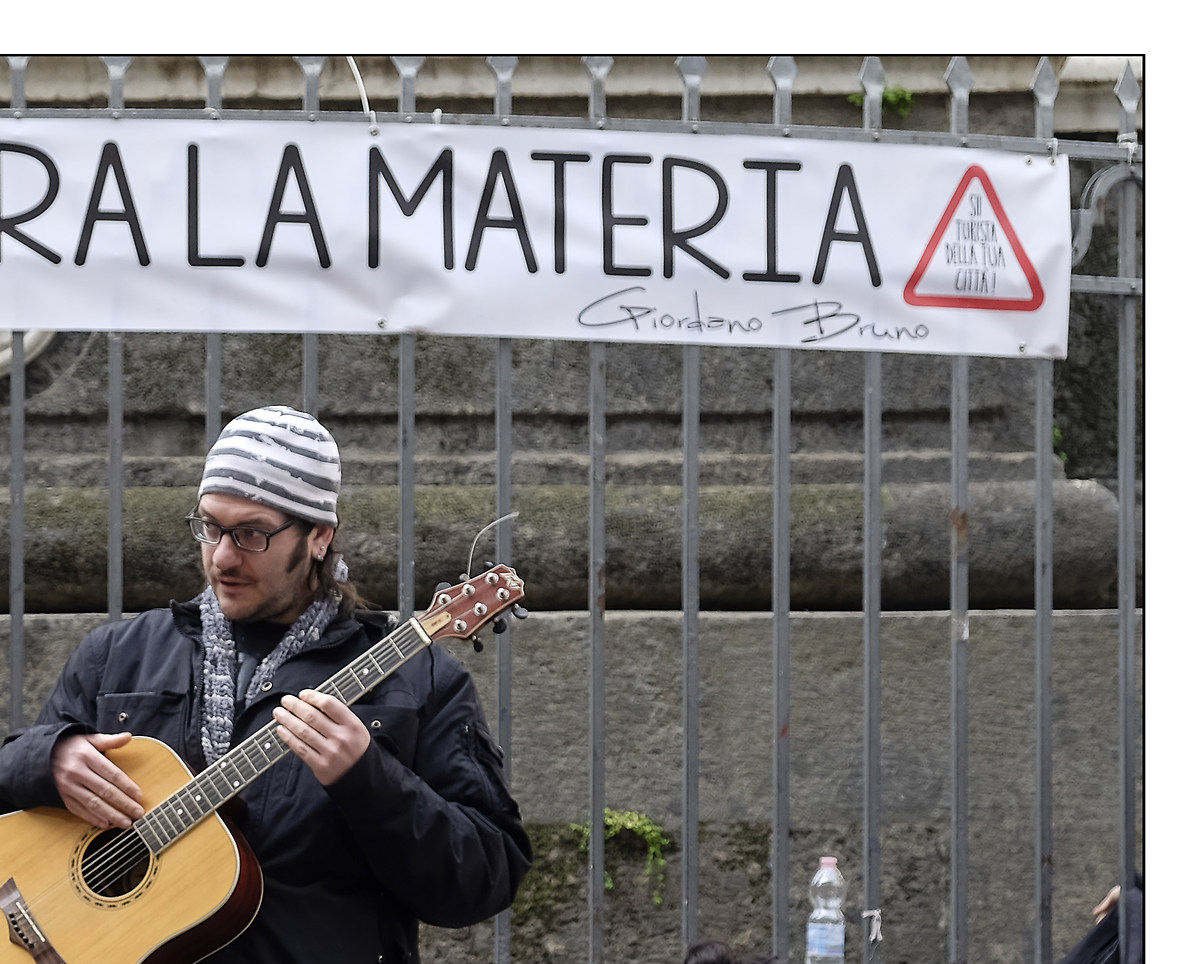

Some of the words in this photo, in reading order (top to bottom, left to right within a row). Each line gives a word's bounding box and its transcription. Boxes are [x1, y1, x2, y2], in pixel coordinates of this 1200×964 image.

[186, 142, 333, 270] LA
[366, 145, 883, 289] MATERIA
[955, 219, 998, 244] TURISTA
[946, 242, 978, 265] DELLA
[981, 244, 1006, 269] TUA
[577, 286, 763, 333] Giordano
[771, 299, 930, 343] Bruno
